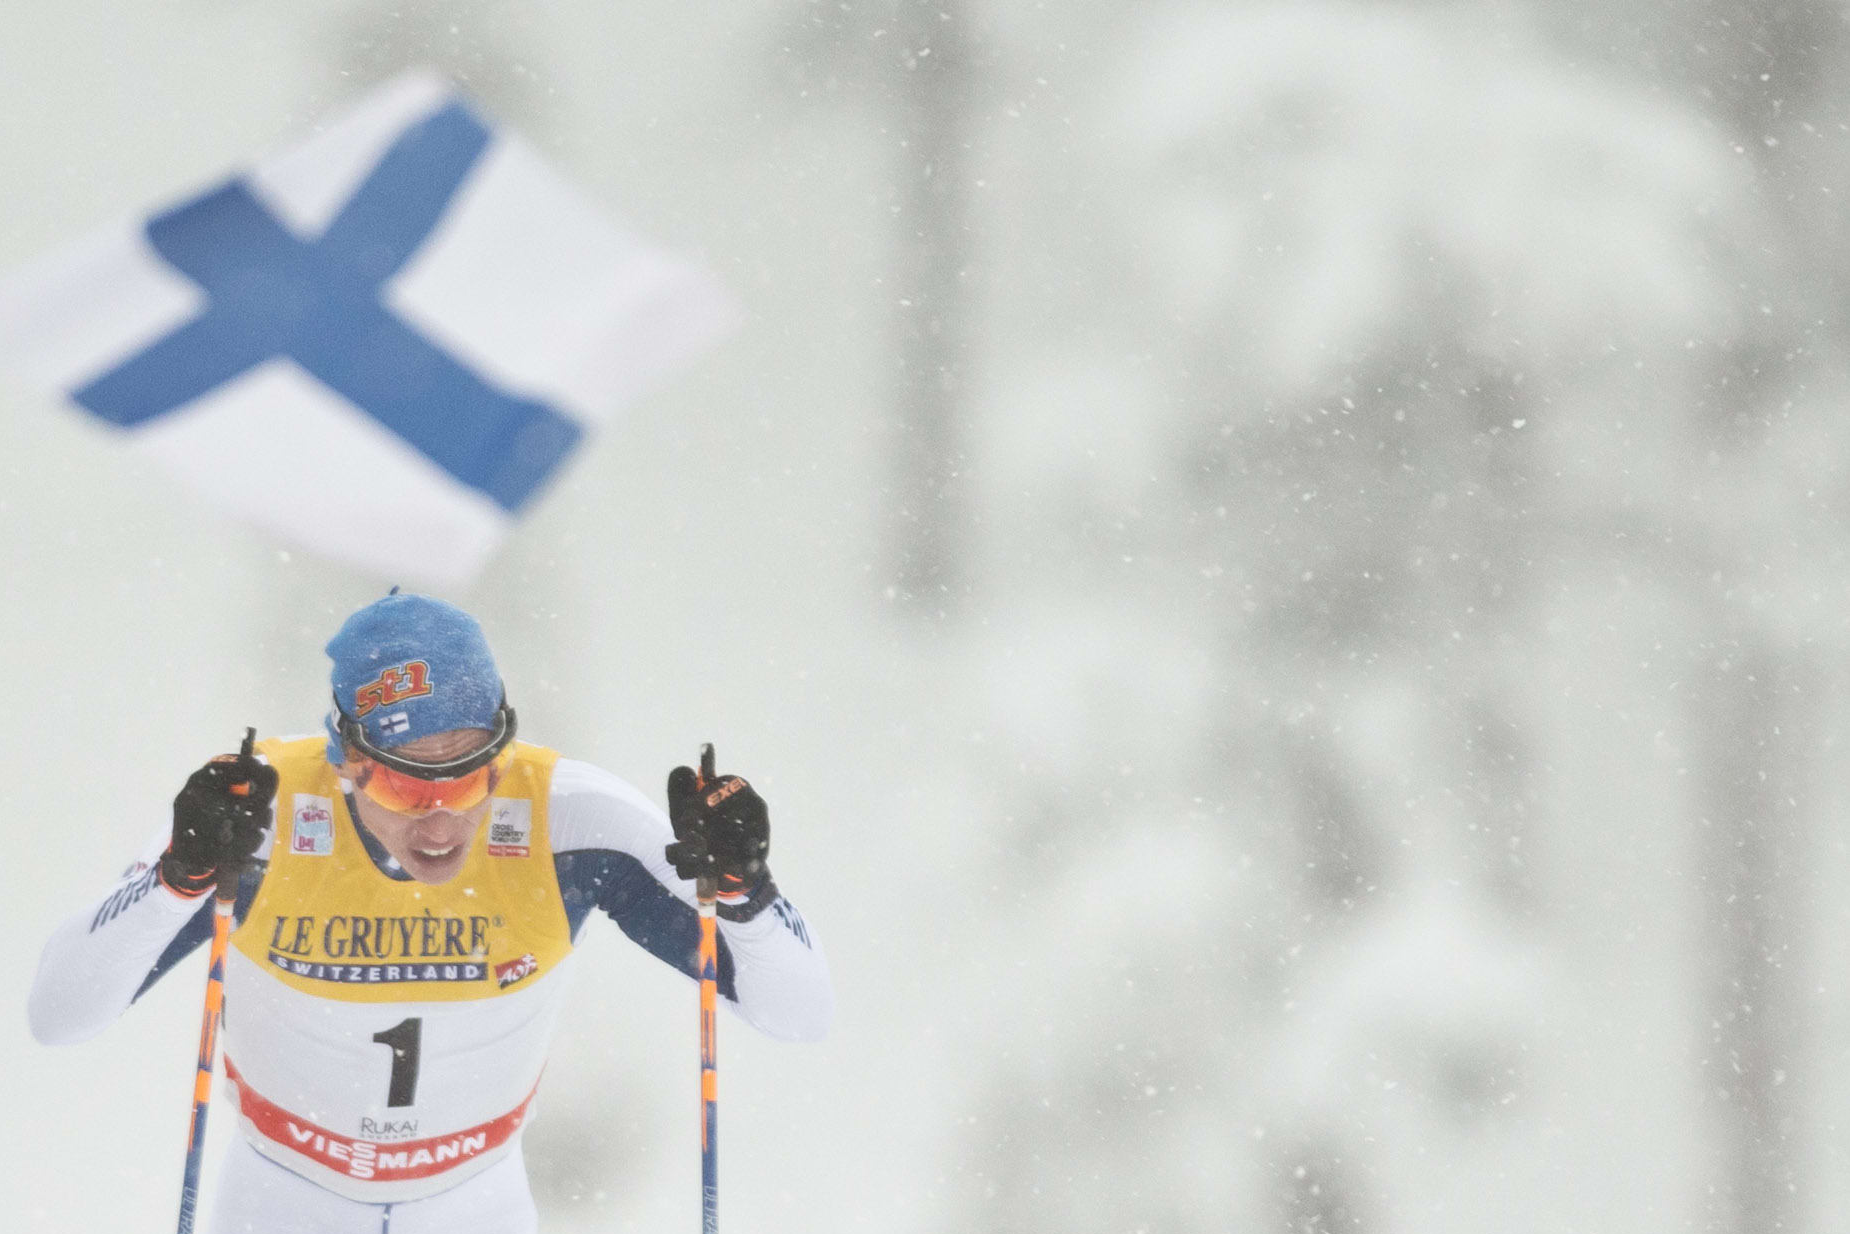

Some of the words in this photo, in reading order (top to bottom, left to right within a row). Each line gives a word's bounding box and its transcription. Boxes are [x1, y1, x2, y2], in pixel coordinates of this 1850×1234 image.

[355, 659, 434, 719] st1
[268, 915, 315, 957] LE
[276, 956, 481, 982] SWITZERLAND
[372, 1017, 424, 1108] 1
[285, 1123, 487, 1180] VIESSMANN
